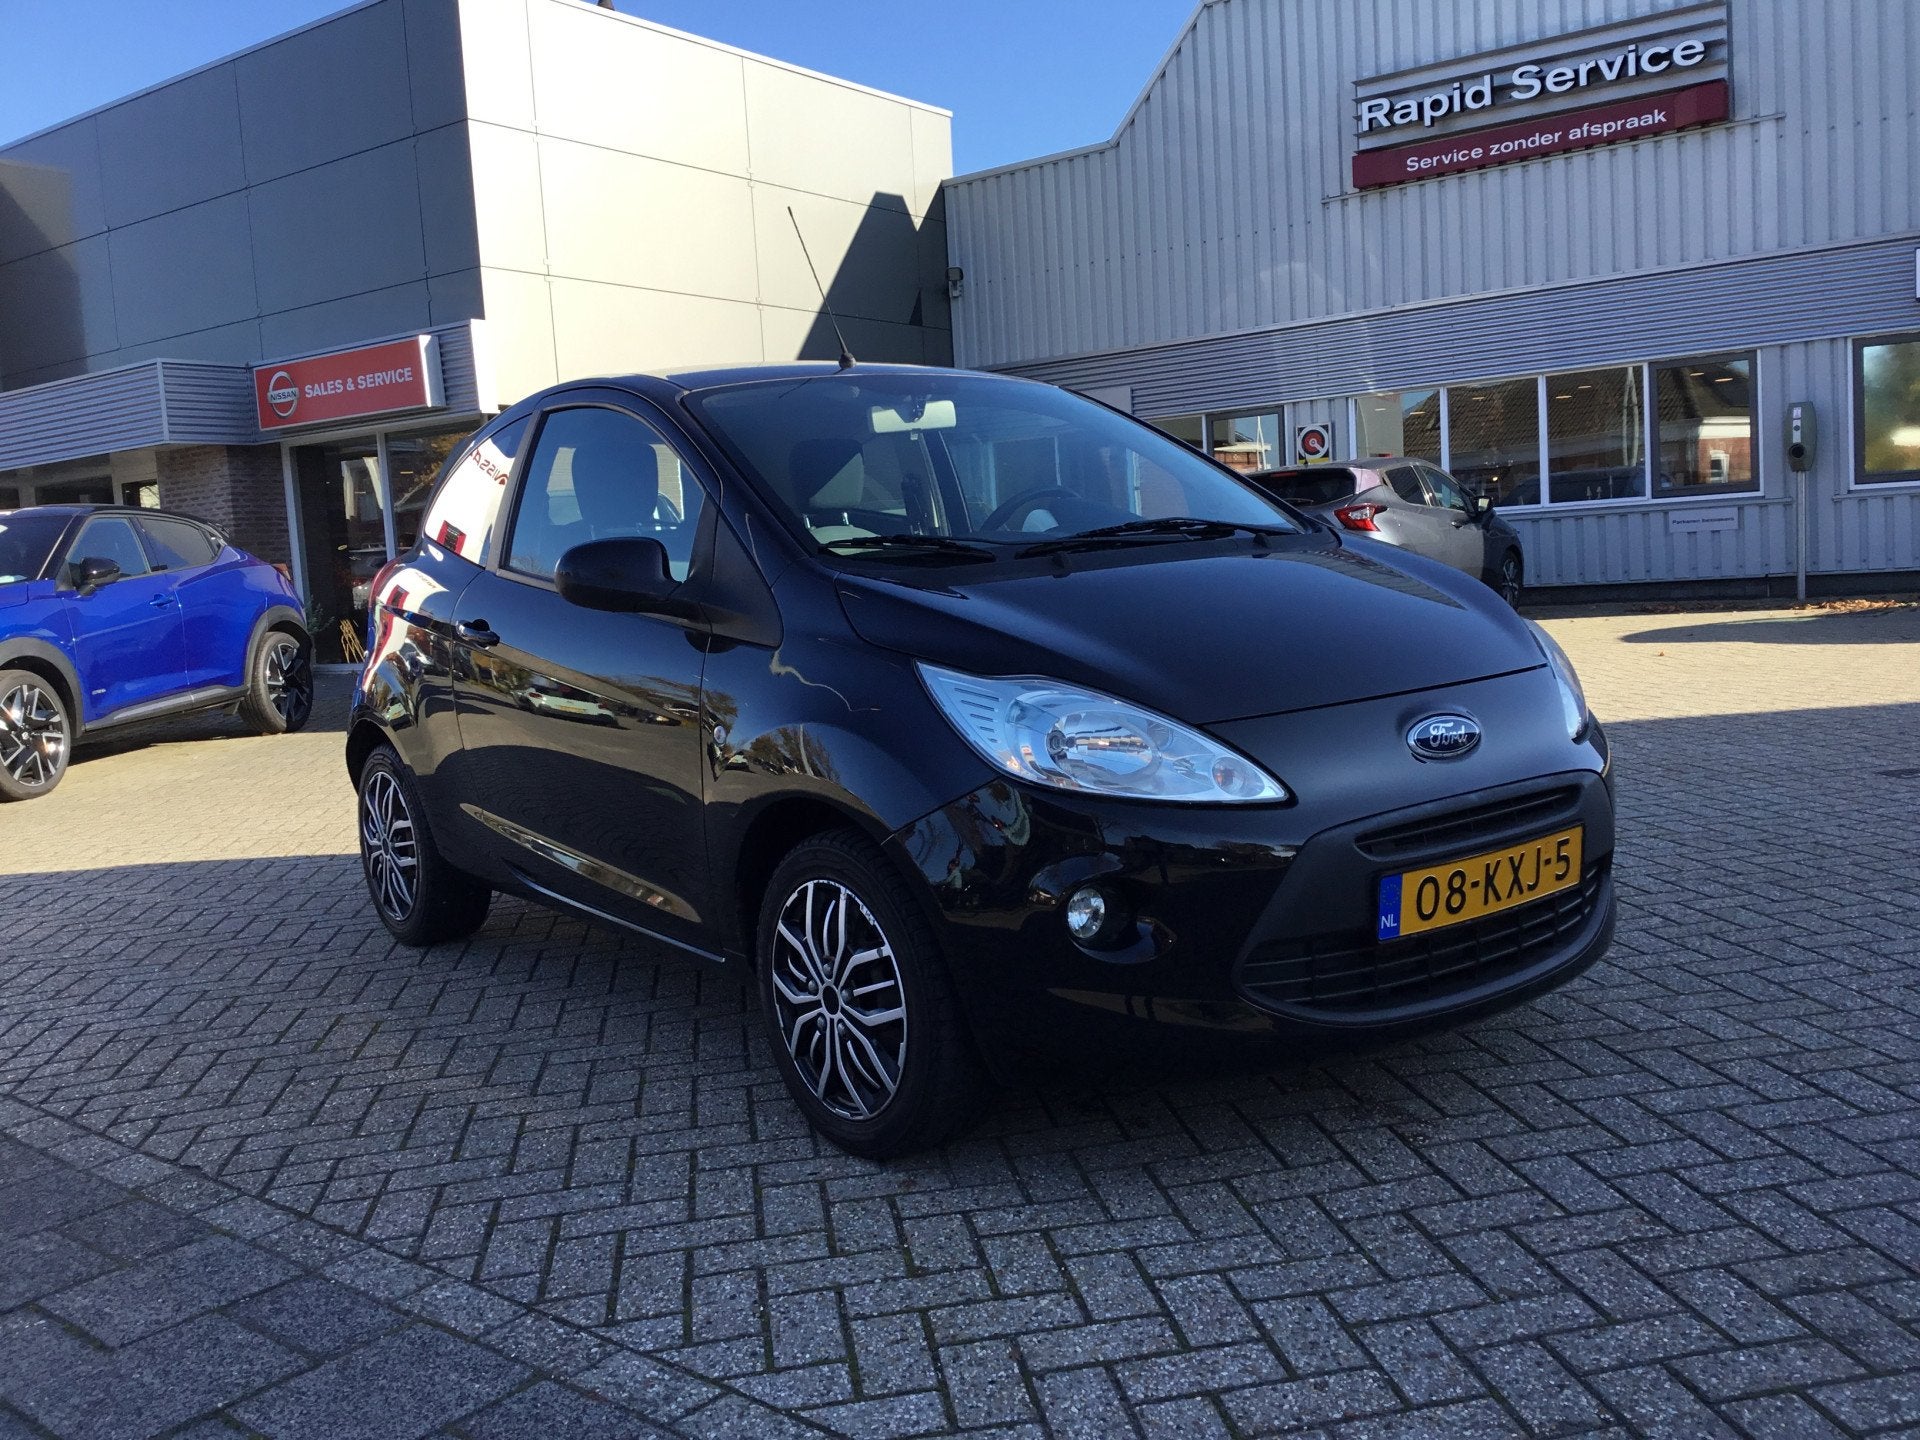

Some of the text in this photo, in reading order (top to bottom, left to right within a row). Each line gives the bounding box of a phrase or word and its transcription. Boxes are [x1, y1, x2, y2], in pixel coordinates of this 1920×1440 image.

[1361, 38, 1706, 131] Rapid Service
[1406, 109, 1668, 172] Service zonder afspraak
[270, 389, 298, 402] NISSAN
[305, 367, 413, 398] SALES & SERVICE
[1429, 721, 1468, 748] Ford
[1415, 837, 1572, 922] 08-KXJ-5
[1380, 914, 1398, 930] NL
